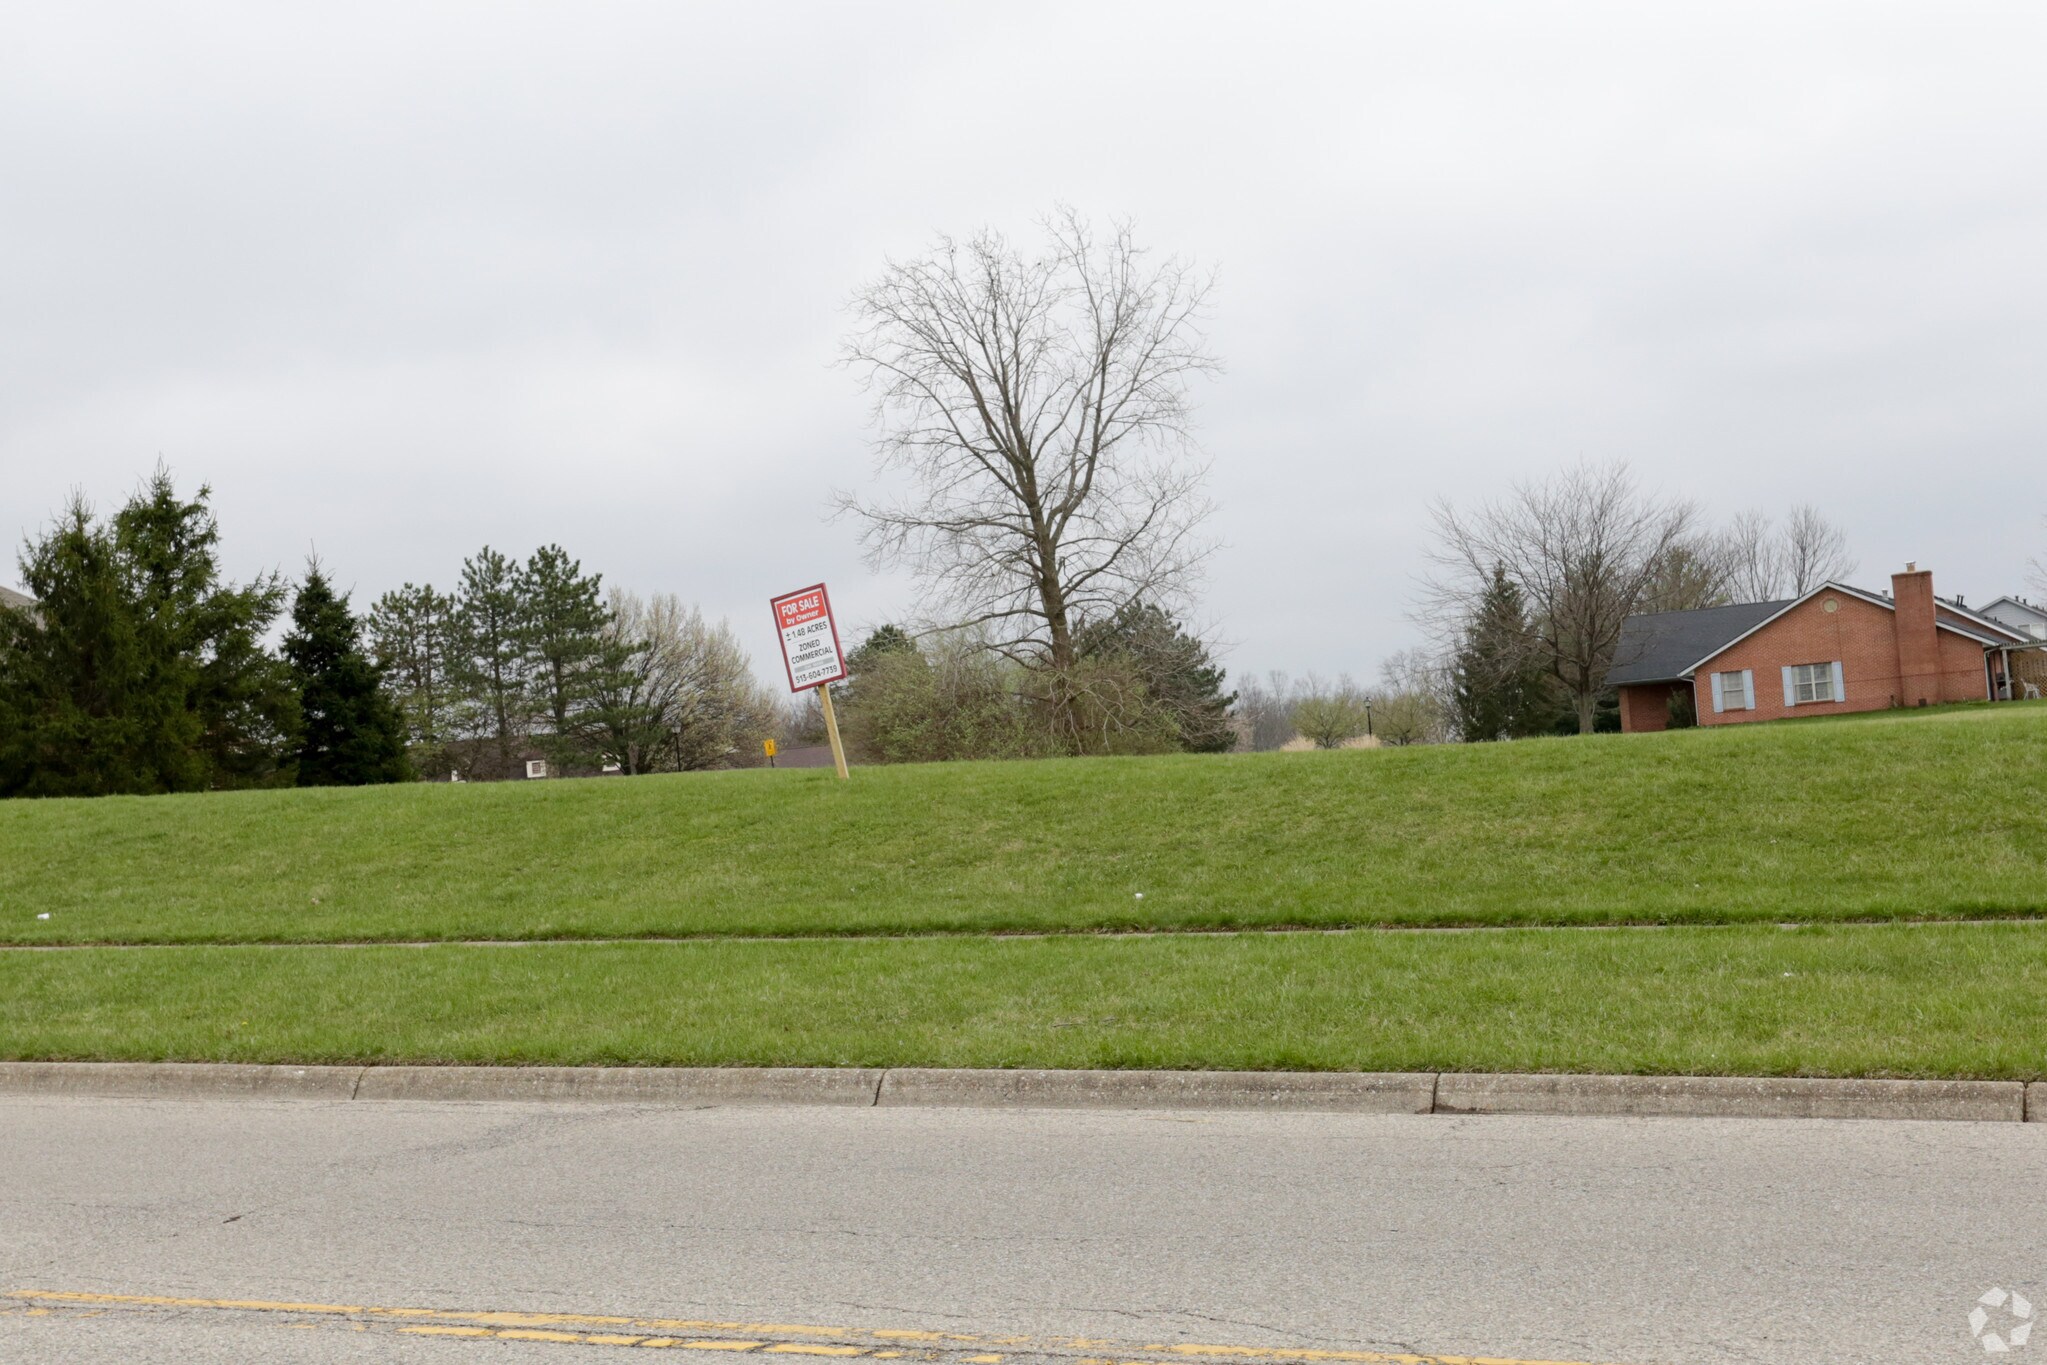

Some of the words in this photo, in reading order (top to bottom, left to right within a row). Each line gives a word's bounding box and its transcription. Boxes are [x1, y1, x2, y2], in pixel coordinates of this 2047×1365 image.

[781, 602, 798, 617] FOR
[799, 596, 820, 611] SALE
[786, 617, 795, 625] by
[796, 610, 819, 621] Owner
[792, 628, 806, 638] 1.48
[807, 621, 827, 633] ACRES
[799, 639, 820, 651] ZONED
[791, 646, 833, 664] COMMERCIAL
